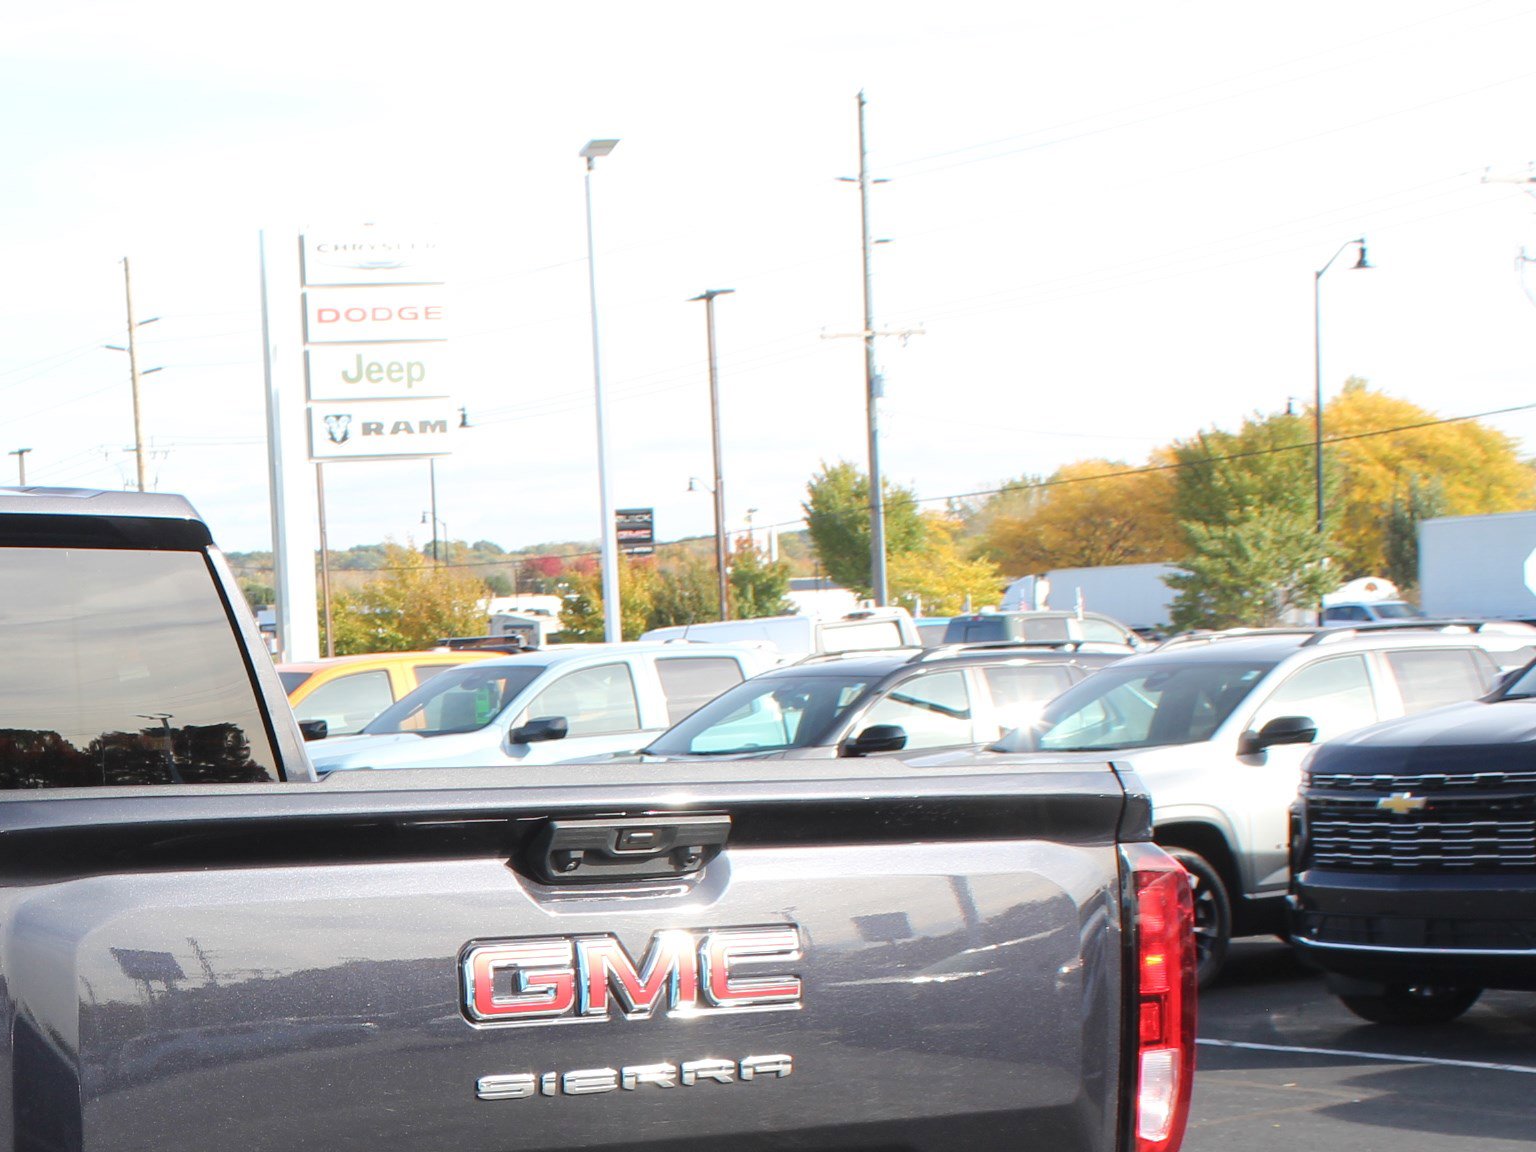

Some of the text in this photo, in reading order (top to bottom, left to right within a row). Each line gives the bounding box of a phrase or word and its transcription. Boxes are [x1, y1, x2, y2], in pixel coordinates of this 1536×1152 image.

[317, 306, 444, 324] DODGE
[341, 353, 426, 388] Jeep
[361, 420, 448, 436] RAM
[458, 922, 804, 1029] GMC
[476, 1053, 793, 1101] SIERRA
